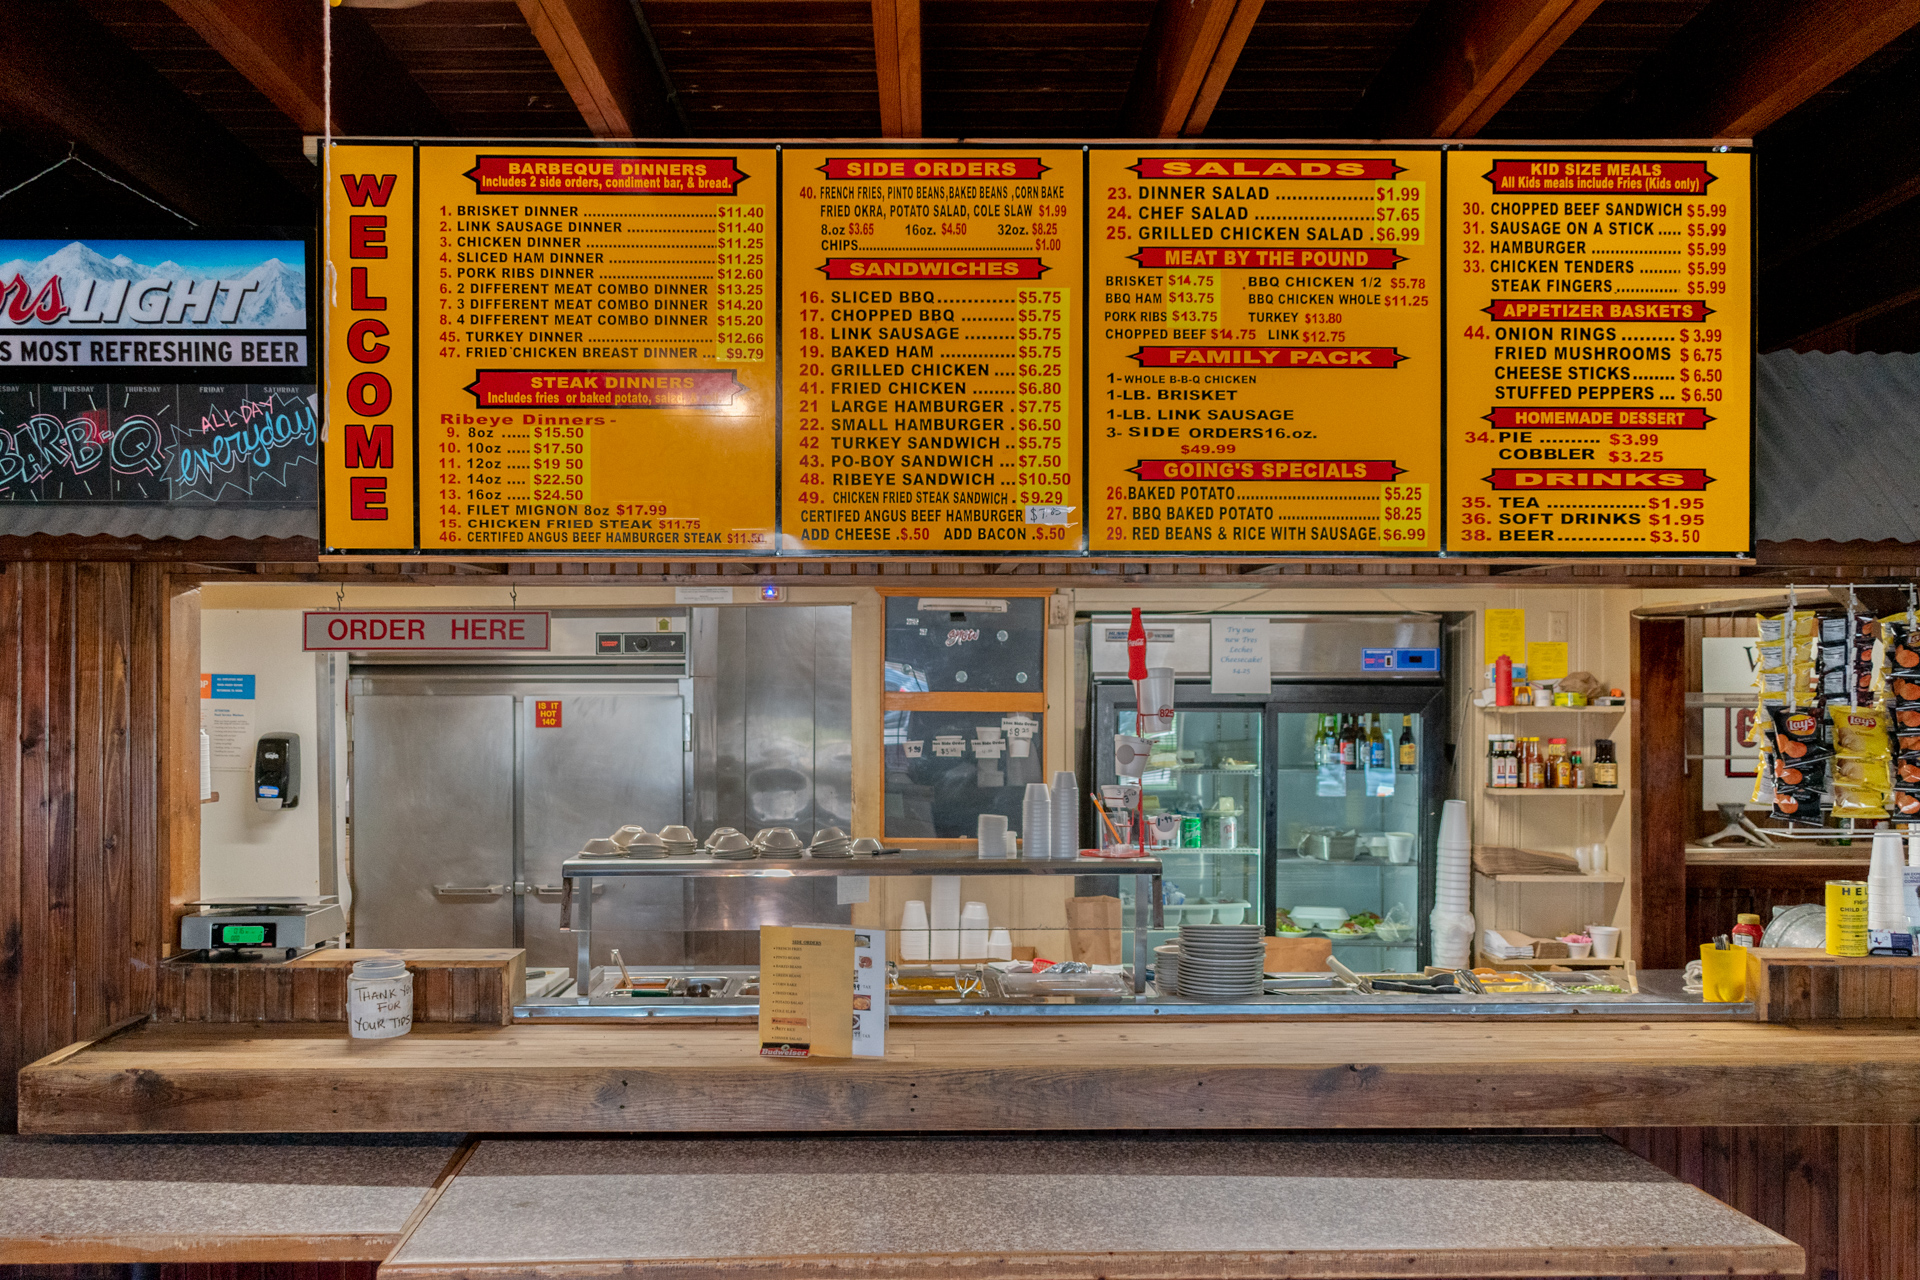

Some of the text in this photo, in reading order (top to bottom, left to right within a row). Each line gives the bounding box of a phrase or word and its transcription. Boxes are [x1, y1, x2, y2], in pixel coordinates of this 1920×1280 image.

[509, 163, 706, 176] BARBEQUE DINNERS
[847, 162, 1016, 176] SIDE ORDERS
[1163, 162, 1364, 176] SALADS
[1531, 164, 1661, 176] KID SIZE MEALS
[483, 176, 731, 190] Includes 2 side orders, condiment bar, & bread.
[1501, 176, 1699, 192] All Kids meals include Fries (Kids only)
[800, 187, 816, 199] 40.
[821, 187, 854, 199] FRENCH
[858, 186, 884, 201] FRIES,
[888, 187, 913, 199] PINTO
[980, 186, 1007, 198] BEANS
[1042, 186, 1064, 198] BAKE
[441, 206, 763, 217] 1. BRISKET DINNER $11.40
[821, 223, 873, 235] 8.oz $3.65
[906, 223, 966, 235] 16oz. $4.50
[1166, 250, 1368, 266] MEAT BY THE POUND
[850, 262, 1019, 275] SANDWICHES
[440, 283, 762, 295] 6. 2 DIFFERENT MEAT COMBO DINNER $13.25
[1249, 277, 1425, 289] BBQ CHICKEN 1/2 $5.78
[69, 279, 260, 324] LIGHT
[1504, 304, 1692, 317] APPETIZER BASKETS
[21, 341, 81, 362] MOST
[90, 341, 232, 362] REFRESHING
[241, 341, 299, 362] BEER
[1170, 351, 1372, 364] FAMILY PACK
[531, 377, 695, 389] STEAK DINNERS
[800, 382, 1061, 395] 41. FRIED CHICKEN $6.80
[488, 392, 532, 403] Includes
[536, 392, 559, 403] fries
[566, 395, 577, 403] or
[580, 392, 611, 403] baked
[615, 393, 651, 406] potato,
[202, 397, 273, 434] ALL DAY
[441, 414, 605, 427] Ribeye Dinners
[1516, 412, 1685, 424] HOMEMADE DESSERT
[175, 404, 317, 482] everyday
[1181, 445, 1235, 454] $49.99
[1499, 449, 1663, 463] COBBLER $3.25
[1164, 463, 1366, 478] GOING'S SPECIALS
[1516, 473, 1684, 486] DRINKS
[801, 510, 1023, 522] CERTIFED ANGUS BEEF HAMBURGER
[1462, 513, 1704, 526] 36. SOFT DRINKS $1.95
[440, 531, 461, 542] 46.
[468, 532, 523, 542] CERTIFED
[528, 532, 567, 542] ANGUS
[573, 532, 601, 542] BEEF
[607, 532, 679, 543] HAMBURGER
[684, 533, 721, 543] STEAK
[328, 619, 525, 640] ORDER HERE
[538, 702, 558, 710] IS IT
[540, 710, 557, 718] HOT
[354, 987, 396, 1001] THANK
[377, 1001, 401, 1012] FOR
[354, 1015, 411, 1031] YOUR TIPS
